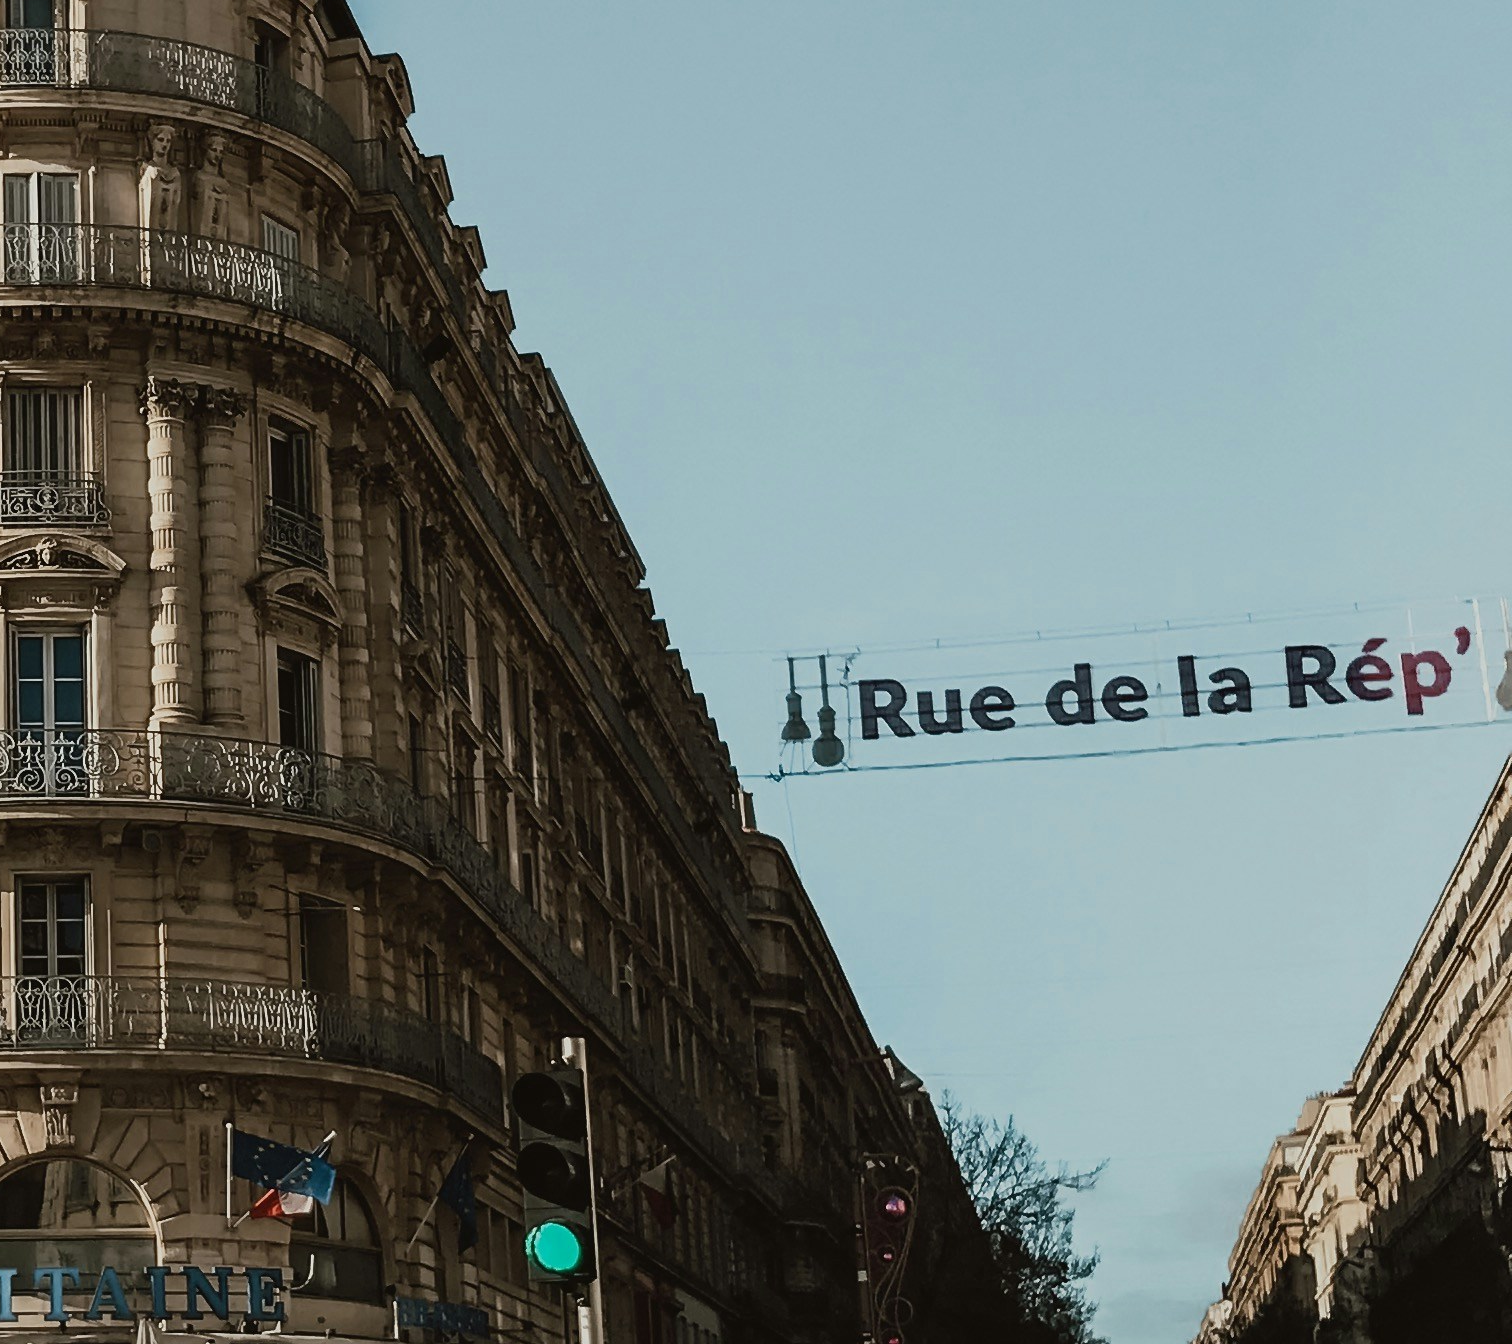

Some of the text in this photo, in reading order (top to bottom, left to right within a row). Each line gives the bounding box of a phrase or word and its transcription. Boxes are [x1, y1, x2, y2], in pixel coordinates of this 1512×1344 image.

[858, 625, 1472, 741] Rue de la Rép'
